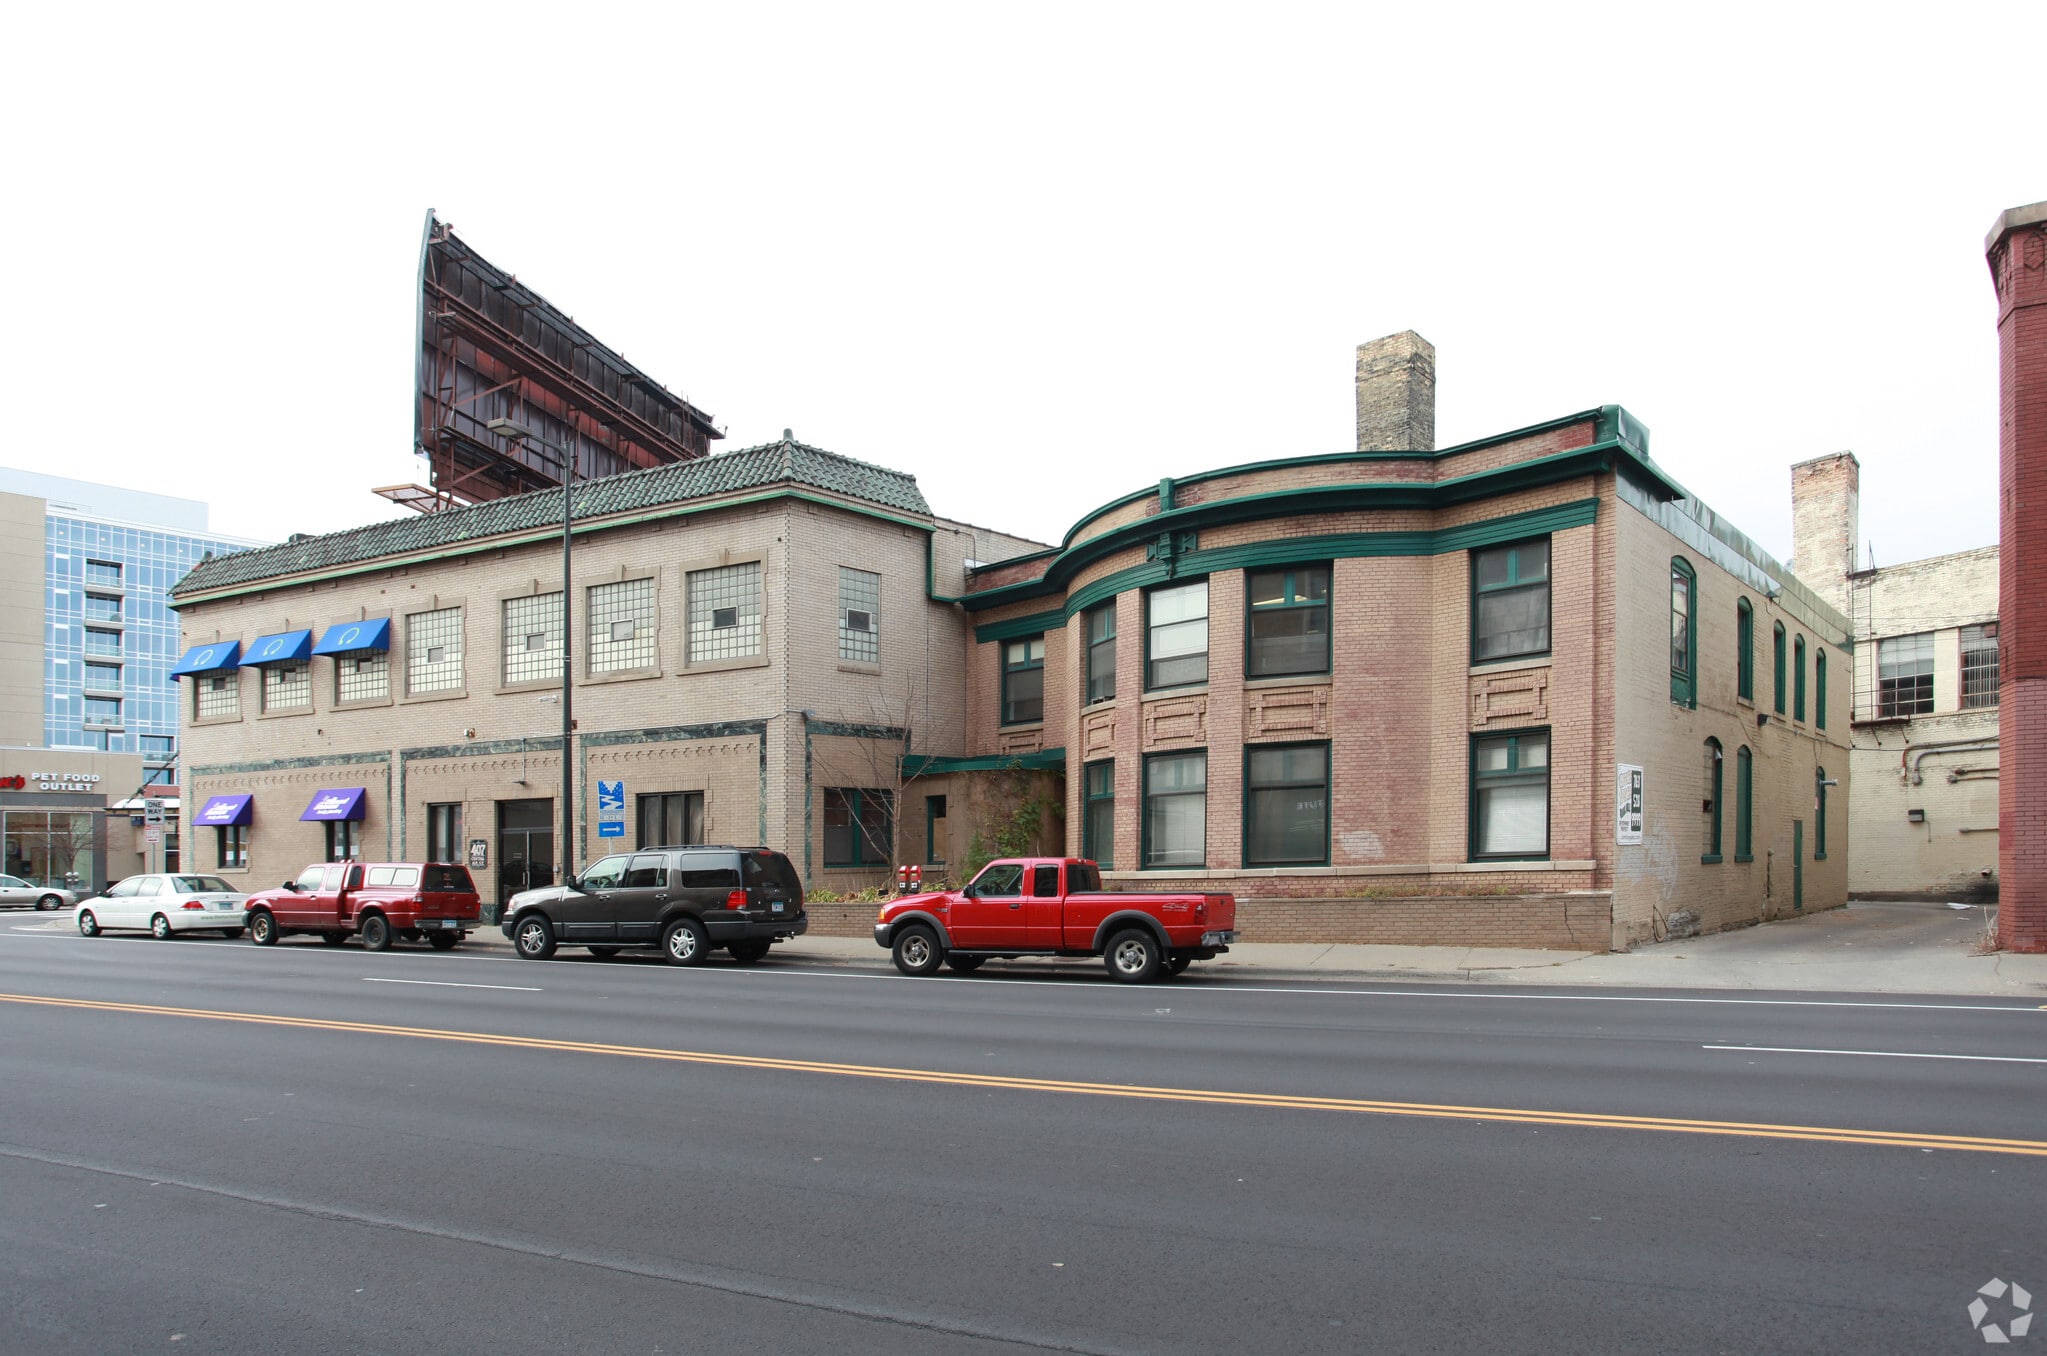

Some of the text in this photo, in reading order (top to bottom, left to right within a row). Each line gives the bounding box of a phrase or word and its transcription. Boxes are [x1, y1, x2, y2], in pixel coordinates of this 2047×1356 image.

[31, 772, 100, 782] PET FOOD
[40, 782, 93, 791] OUTLET
[471, 844, 486, 856] 407
